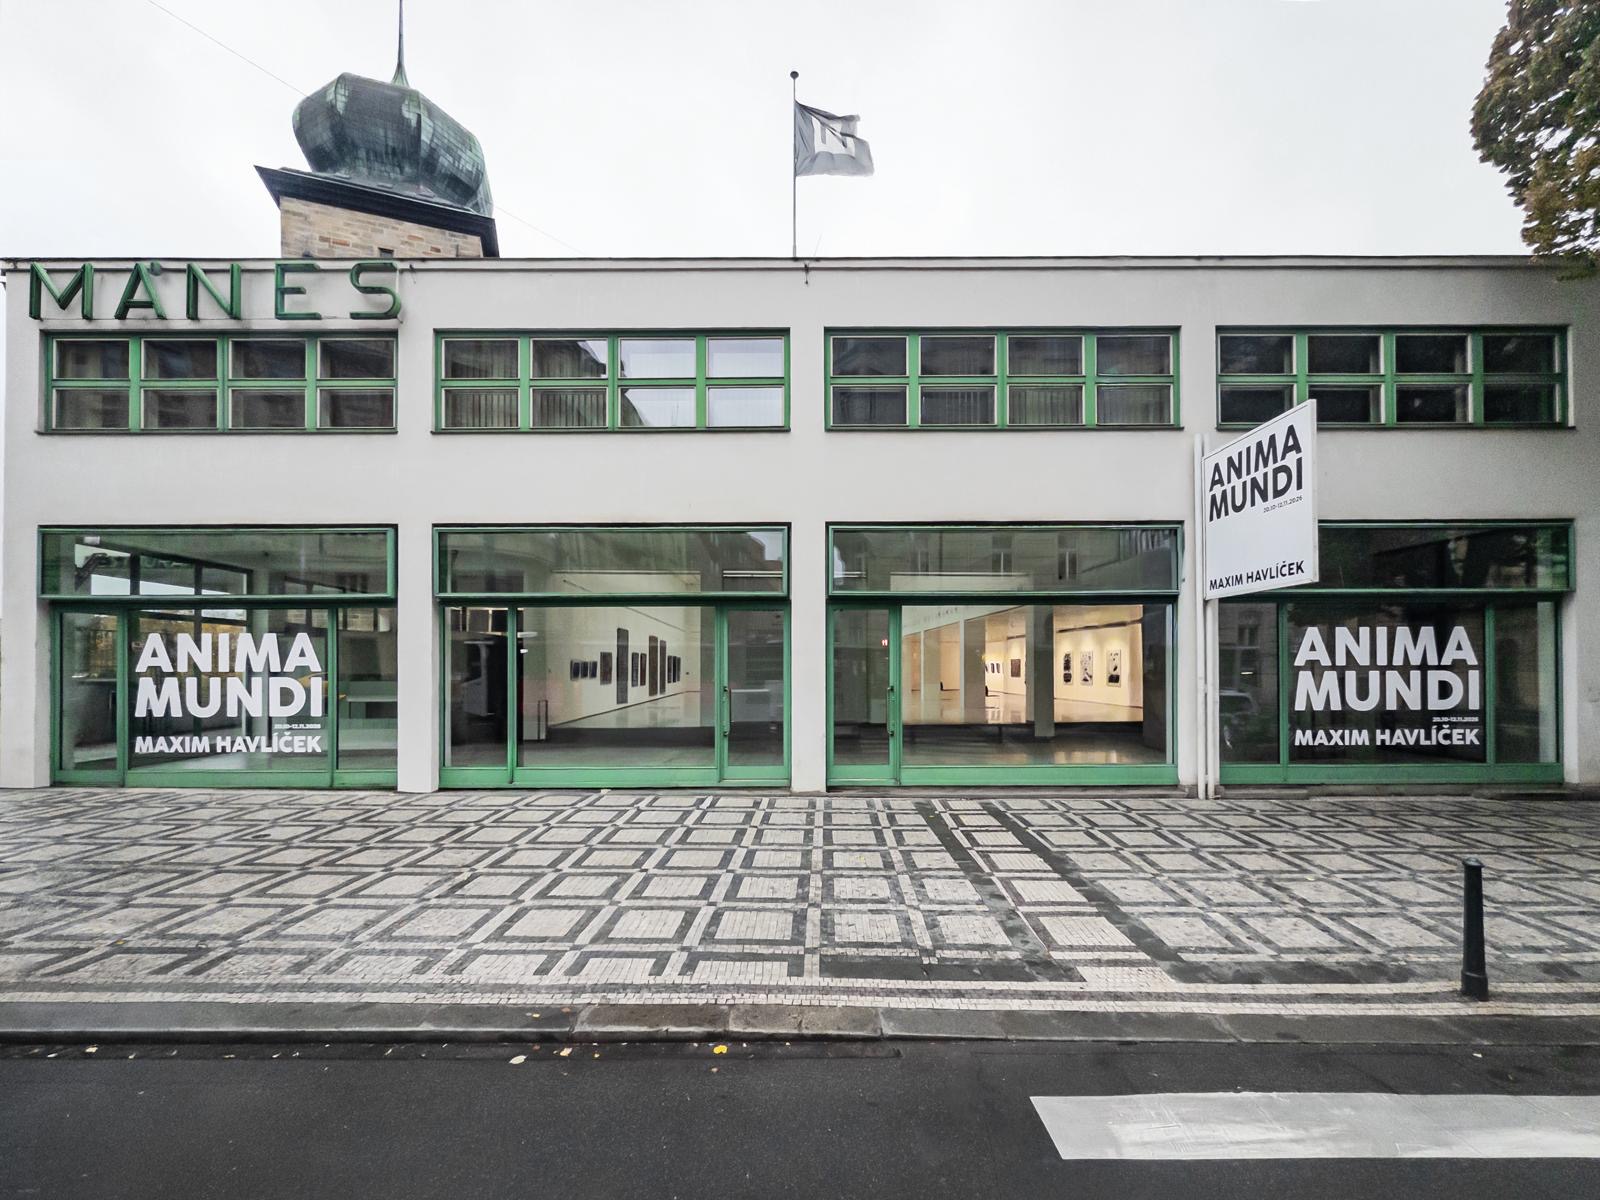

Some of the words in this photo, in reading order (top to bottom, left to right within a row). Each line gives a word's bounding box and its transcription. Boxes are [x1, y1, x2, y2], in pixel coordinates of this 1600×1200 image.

[1209, 424, 1303, 492] ANIMA
[1209, 457, 1303, 522] MUNDI
[1209, 574, 1243, 591] MAXIM
[1246, 560, 1304, 585] HAVLÍČEK
[135, 633, 322, 672] ANIMA
[1294, 626, 1478, 666] ANIMA
[135, 677, 322, 718] MUNDI
[1294, 670, 1480, 711] MUNDI
[135, 736, 210, 753] MAXIM
[216, 732, 322, 753] HAVLÍČEK
[1294, 729, 1370, 746] MAXIM
[1376, 725, 1480, 746] HAVLÍČEK
